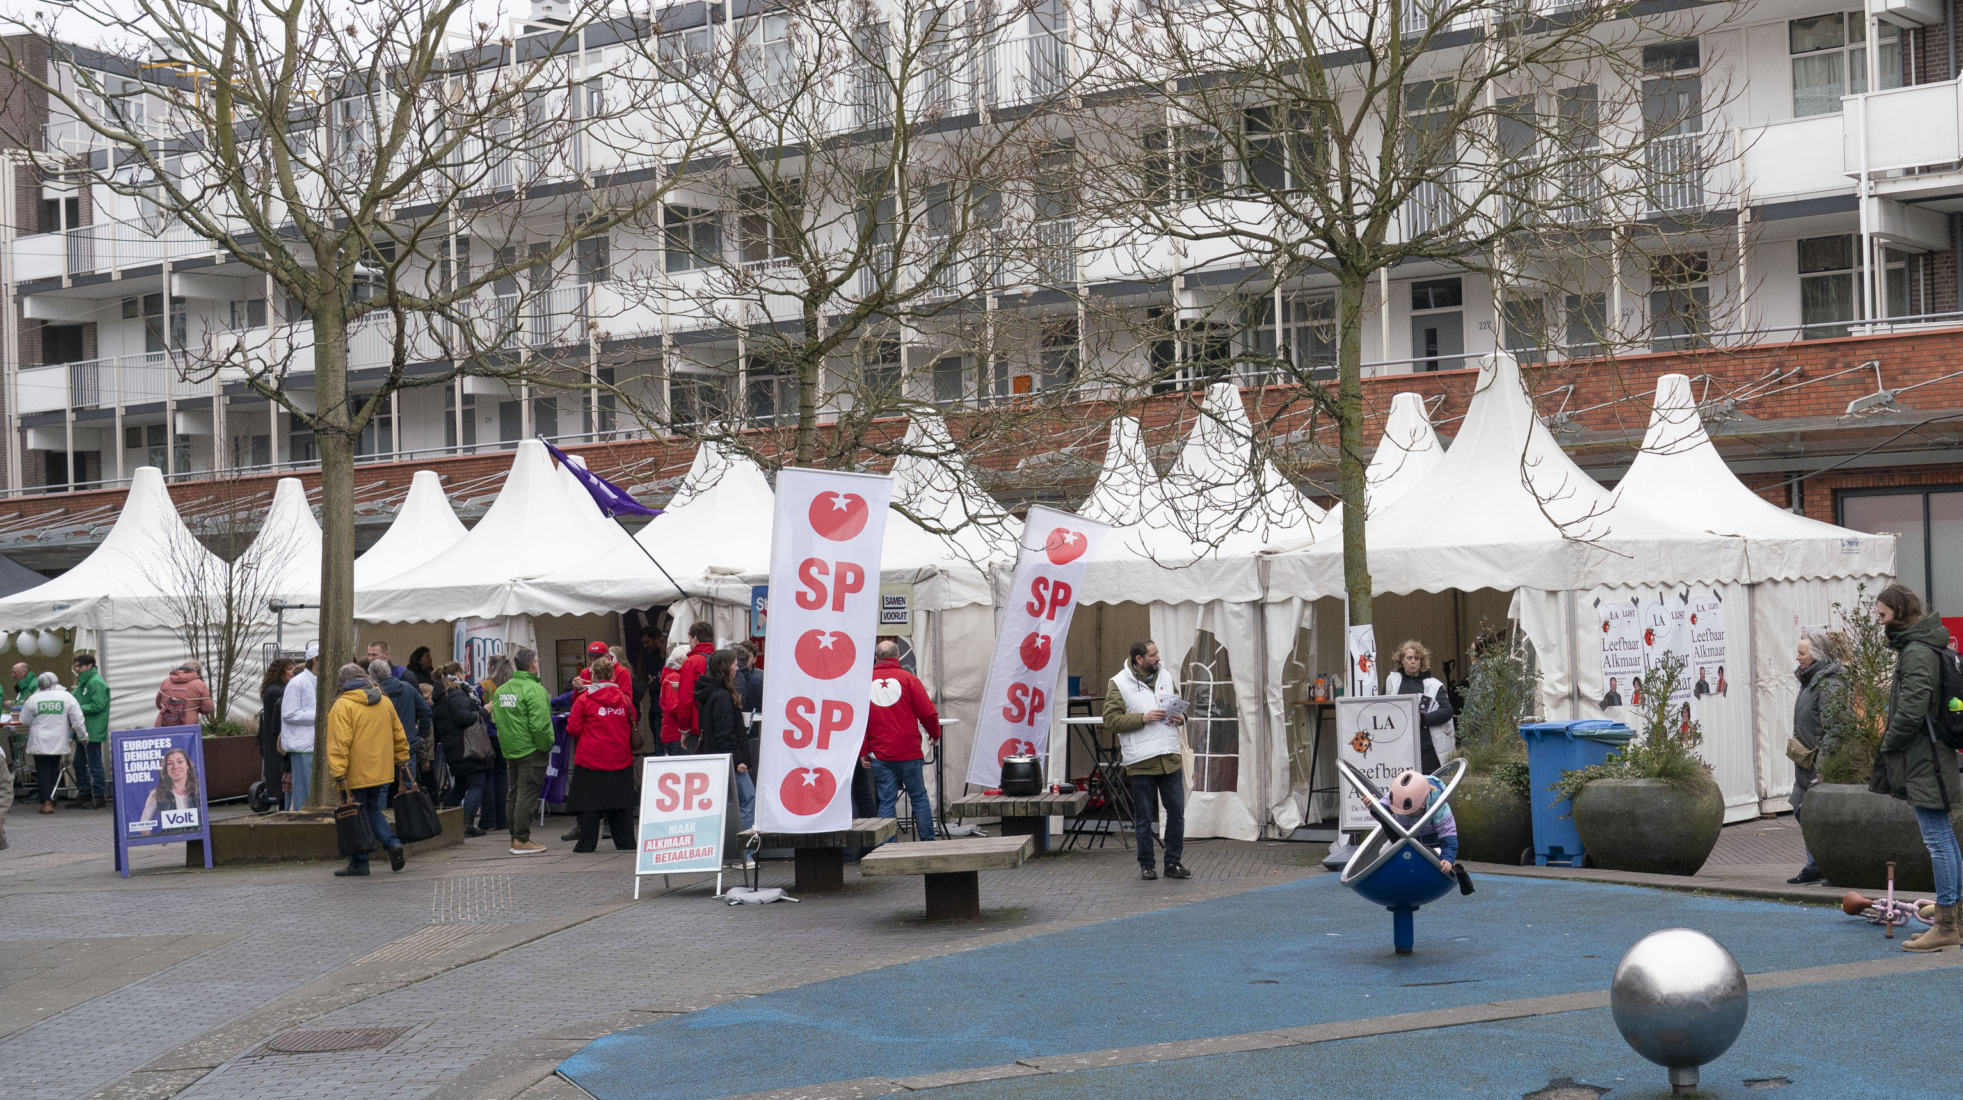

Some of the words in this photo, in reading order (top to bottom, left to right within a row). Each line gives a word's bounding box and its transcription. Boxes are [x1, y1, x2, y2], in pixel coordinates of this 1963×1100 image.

[795, 557, 865, 613] SP
[885, 596, 906, 606] SAMEN
[1026, 576, 1072, 621] SP
[1696, 604, 1705, 612] LA
[883, 611, 908, 621] VOORUIT
[1610, 611, 1619, 620] LA
[1653, 614, 1665, 626] LA
[1691, 628, 1725, 643] Leefbaar
[1602, 637, 1639, 652] Leefbaar
[1694, 644, 1726, 659] Alkmaar
[1603, 653, 1641, 668] Alkmaar
[40, 702, 62, 711] D66
[1002, 682, 1045, 727] SP
[607, 707, 625, 716] PvdA
[782, 696, 854, 750] SP
[1372, 715, 1395, 731] LA
[123, 738, 172, 751] EUROPEES
[124, 749, 165, 762] DENKEN.
[126, 771, 154, 784] DOEN.
[166, 812, 195, 825] Volt
[669, 822, 697, 835] MAAK
[646, 835, 692, 851] ALKMAAR
[655, 846, 714, 863] BETAALBAAR
